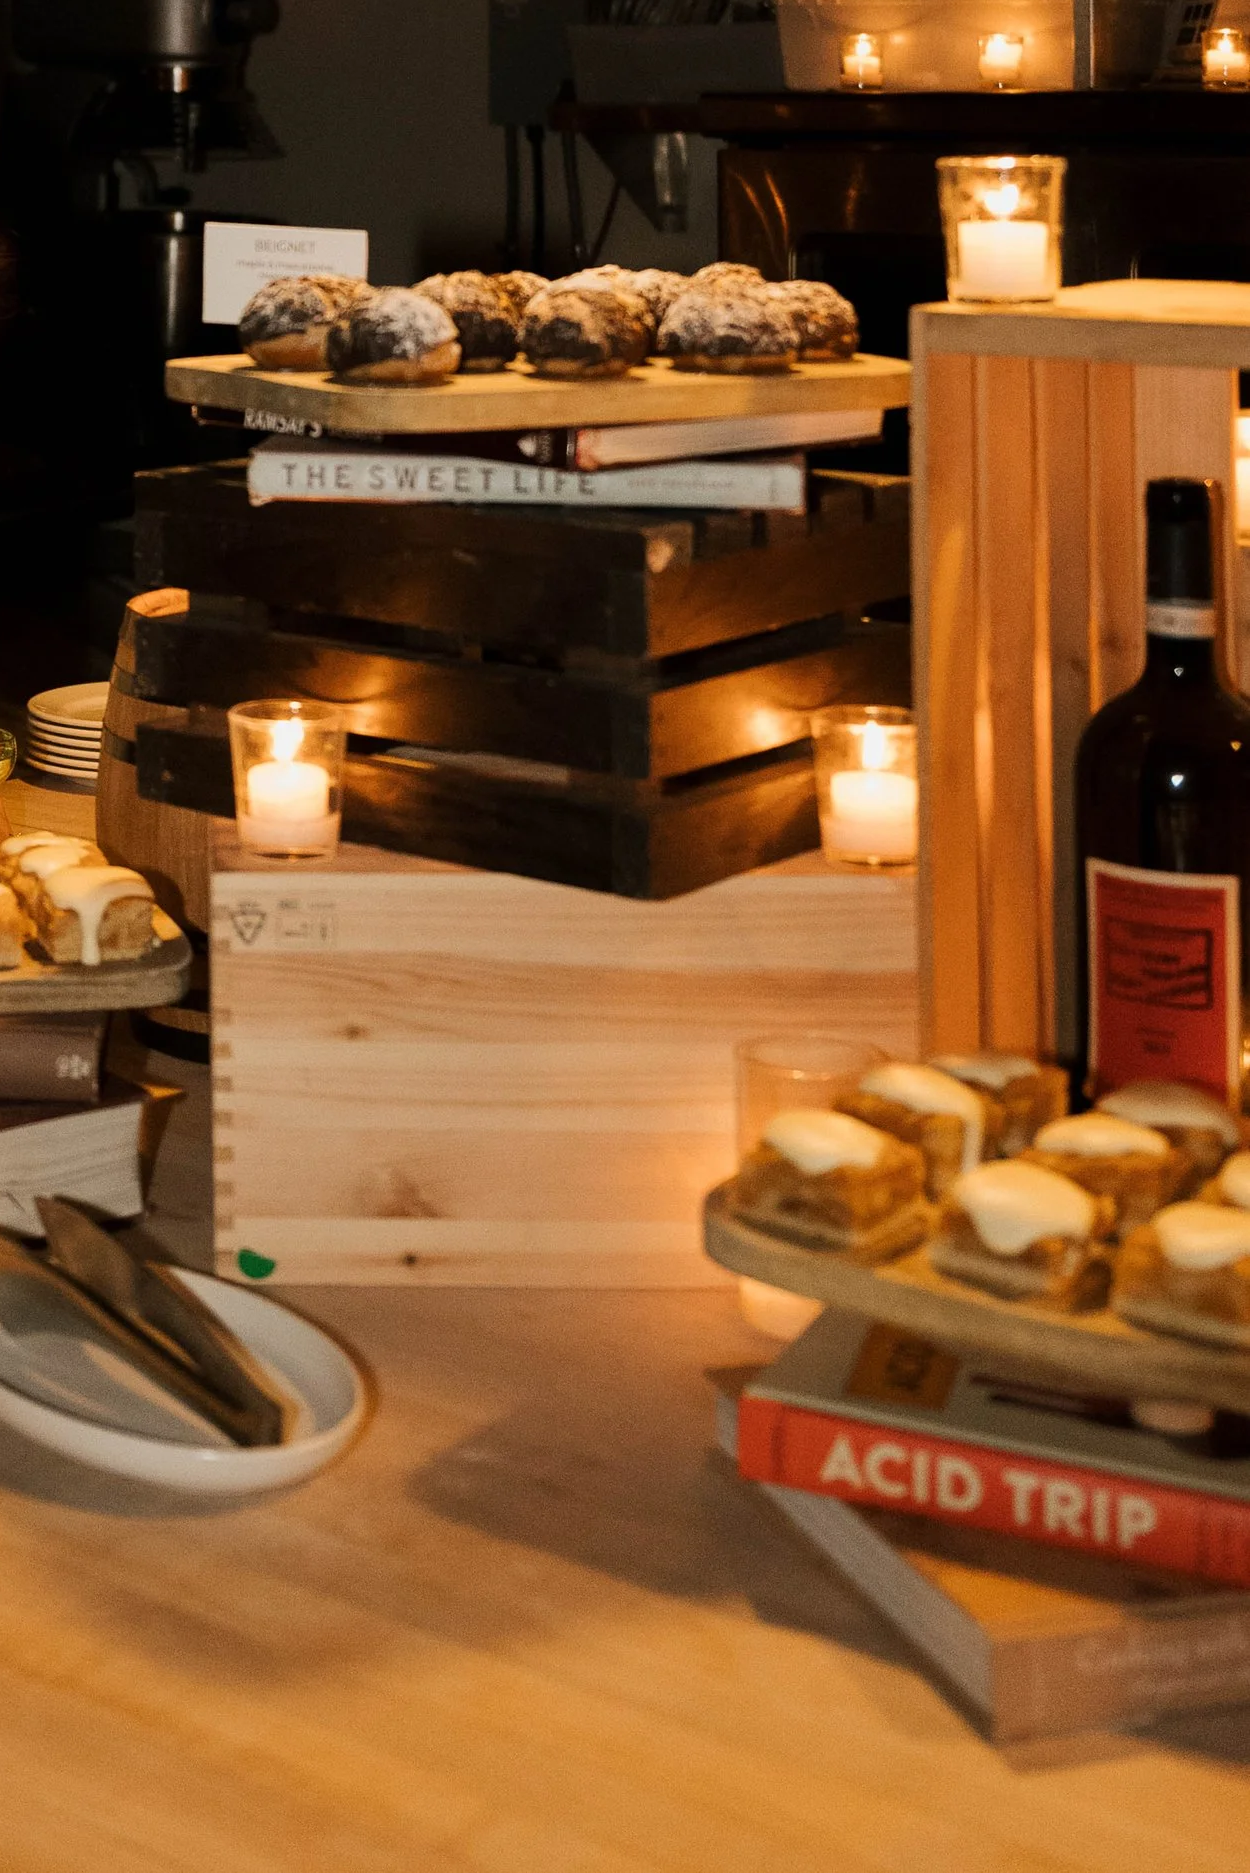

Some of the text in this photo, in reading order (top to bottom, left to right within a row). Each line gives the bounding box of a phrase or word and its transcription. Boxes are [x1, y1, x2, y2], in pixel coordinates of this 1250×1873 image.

[254, 238, 316, 254] BEIGNET
[283, 464, 354, 489] THE
[368, 465, 495, 493] SWEET
[513, 469, 596, 496] LIFE
[817, 1434, 1159, 1551] ACID TRIP
